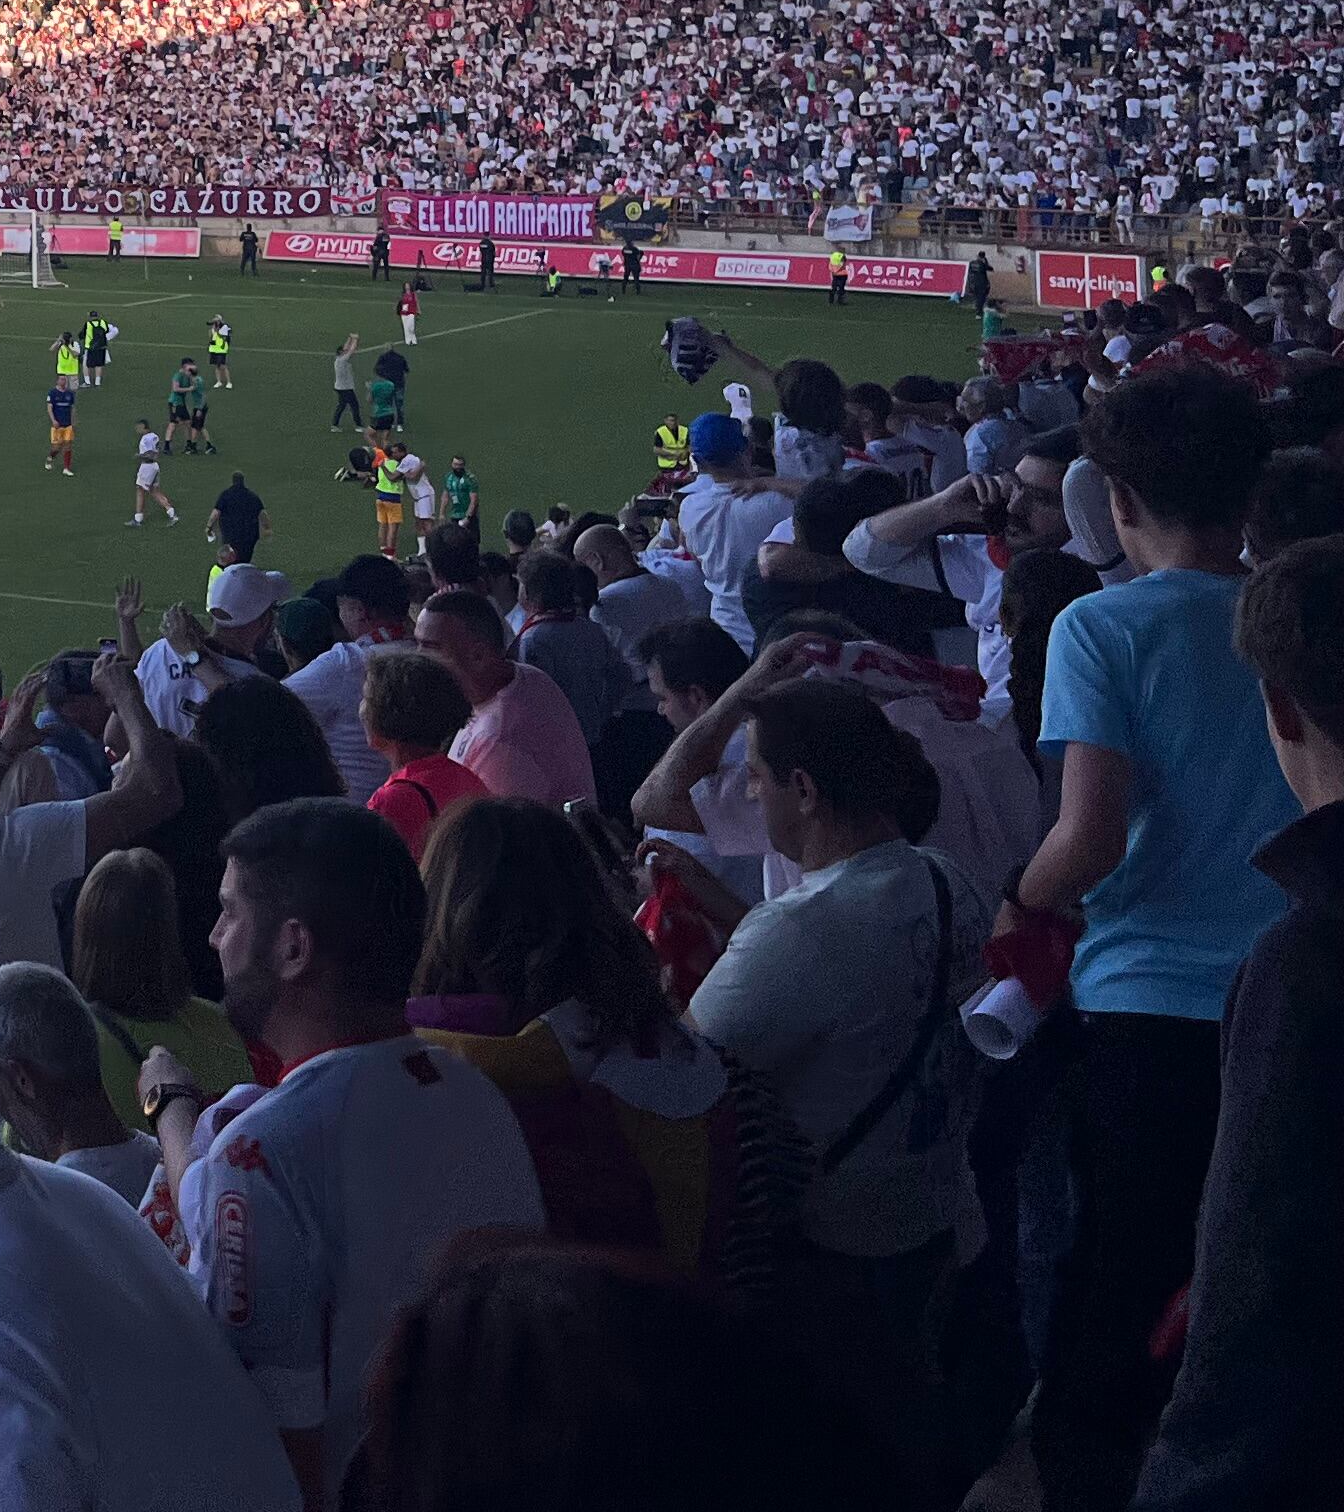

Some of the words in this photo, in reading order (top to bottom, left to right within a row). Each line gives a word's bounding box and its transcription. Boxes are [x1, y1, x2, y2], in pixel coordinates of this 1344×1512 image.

[150, 189, 321, 215] CAZURRO
[418, 200, 440, 232] EL
[444, 197, 490, 233] LEÓN
[495, 202, 593, 238] RAMPANTE
[316, 238, 373, 254] HYUND
[466, 245, 549, 264] HUNDAI
[717, 258, 787, 278] aspire.qa
[857, 264, 934, 281] ASPIRE
[864, 277, 923, 289] ACADEMY
